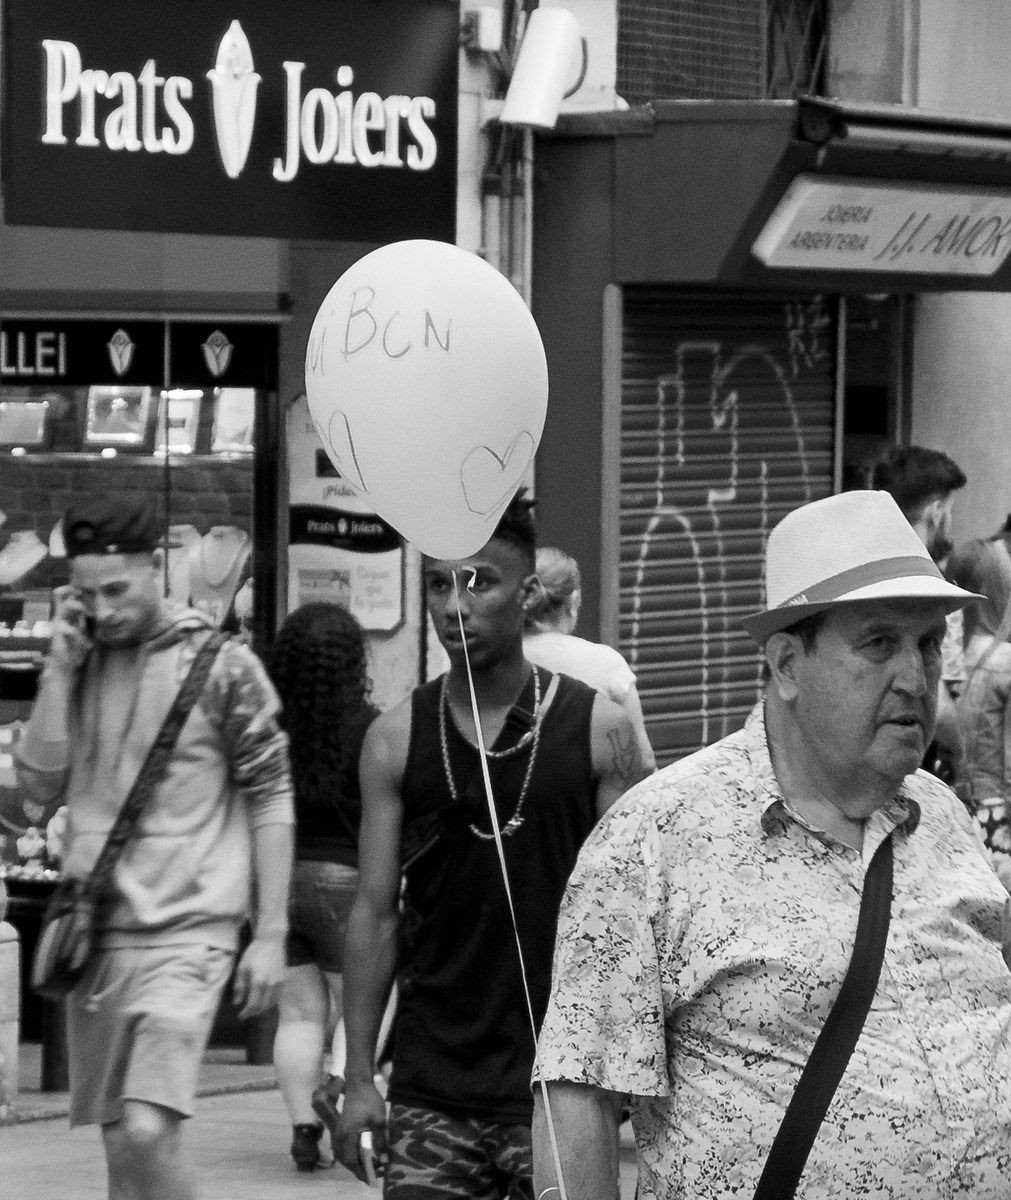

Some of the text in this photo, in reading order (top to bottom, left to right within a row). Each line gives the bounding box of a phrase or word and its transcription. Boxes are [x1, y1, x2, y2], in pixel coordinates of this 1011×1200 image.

[41, 39, 438, 182] Prats Joiers
[789, 231, 870, 252] ARGENTERIA
[341, 286, 452, 361] BCN
[307, 519, 384, 535] Prats Joiers
